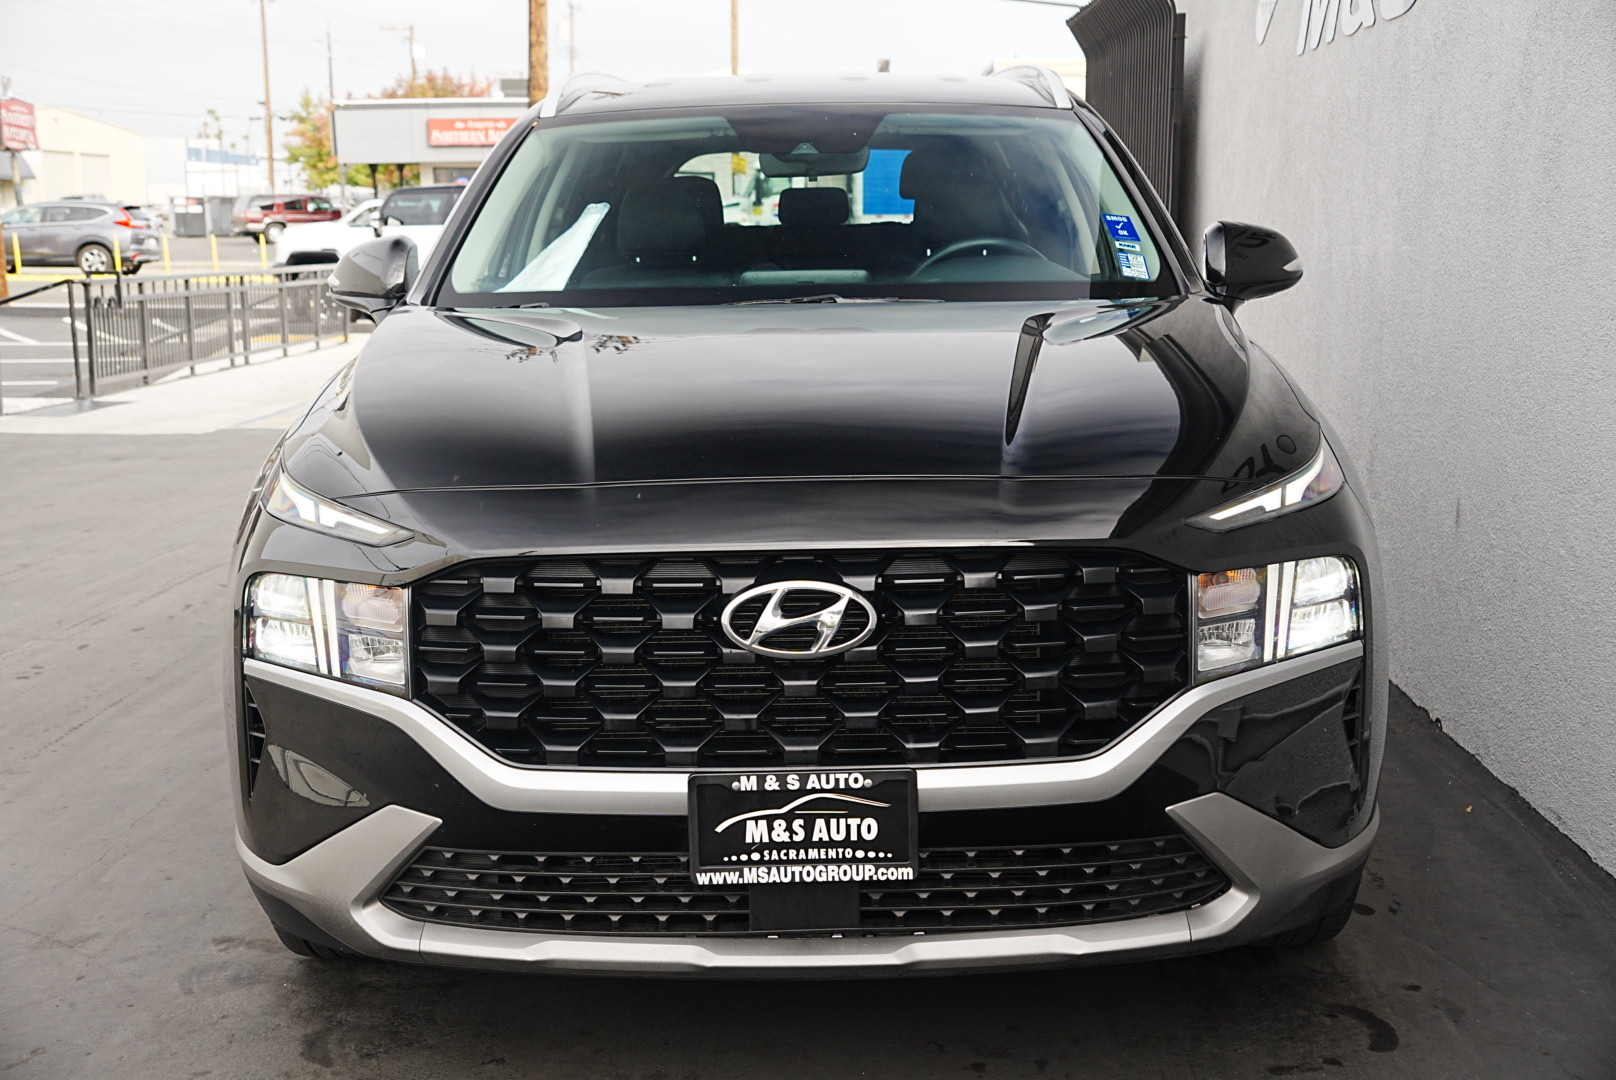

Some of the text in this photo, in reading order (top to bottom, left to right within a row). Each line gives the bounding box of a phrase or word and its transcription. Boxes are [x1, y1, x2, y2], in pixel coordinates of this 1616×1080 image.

[740, 773, 864, 791] M & S AUTO
[745, 817, 879, 844] M&S AUTO
[763, 848, 853, 861] SACRAMENTO
[695, 865, 914, 885] www.MSAUTOGROUP.com
